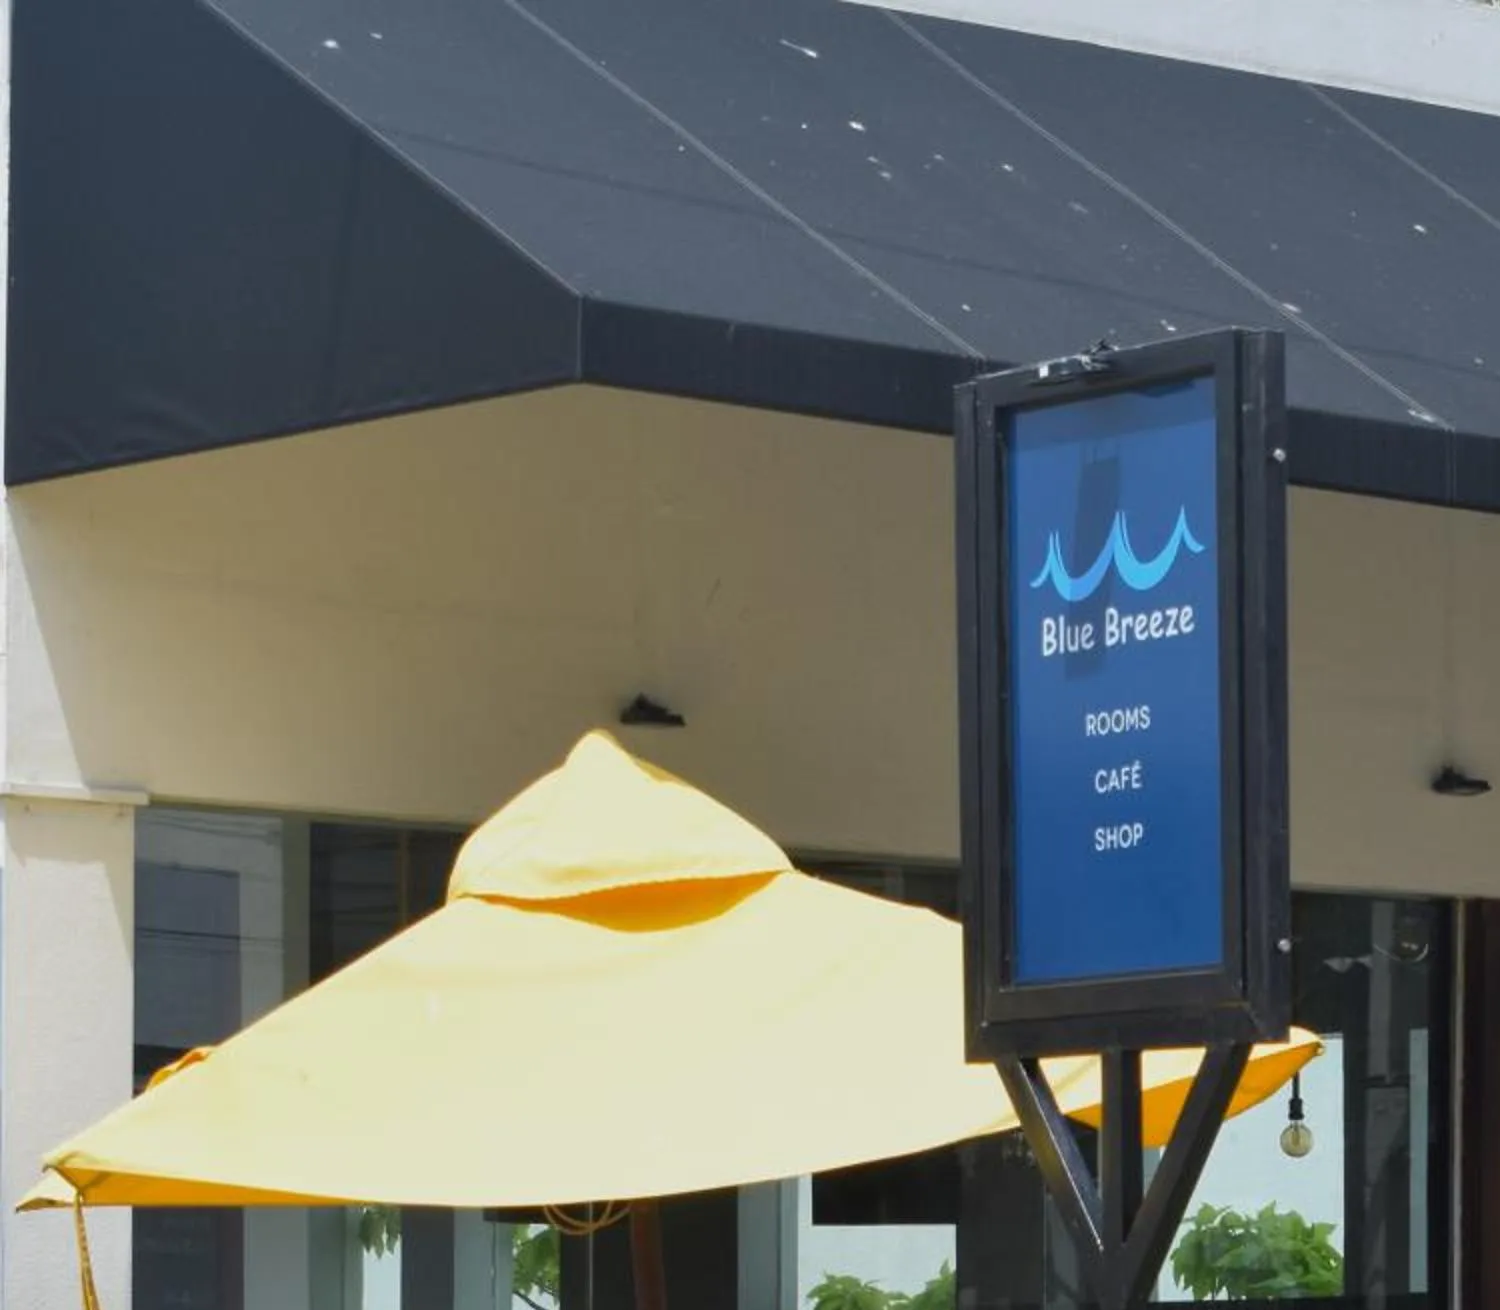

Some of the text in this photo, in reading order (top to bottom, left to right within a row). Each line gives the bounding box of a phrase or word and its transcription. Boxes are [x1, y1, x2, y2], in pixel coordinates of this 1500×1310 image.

[1042, 605, 1195, 657] Blue Breeze
[1085, 705, 1151, 737] ROOMS
[1094, 760, 1143, 794] CAFÉ
[1094, 822, 1143, 852] SHOP
